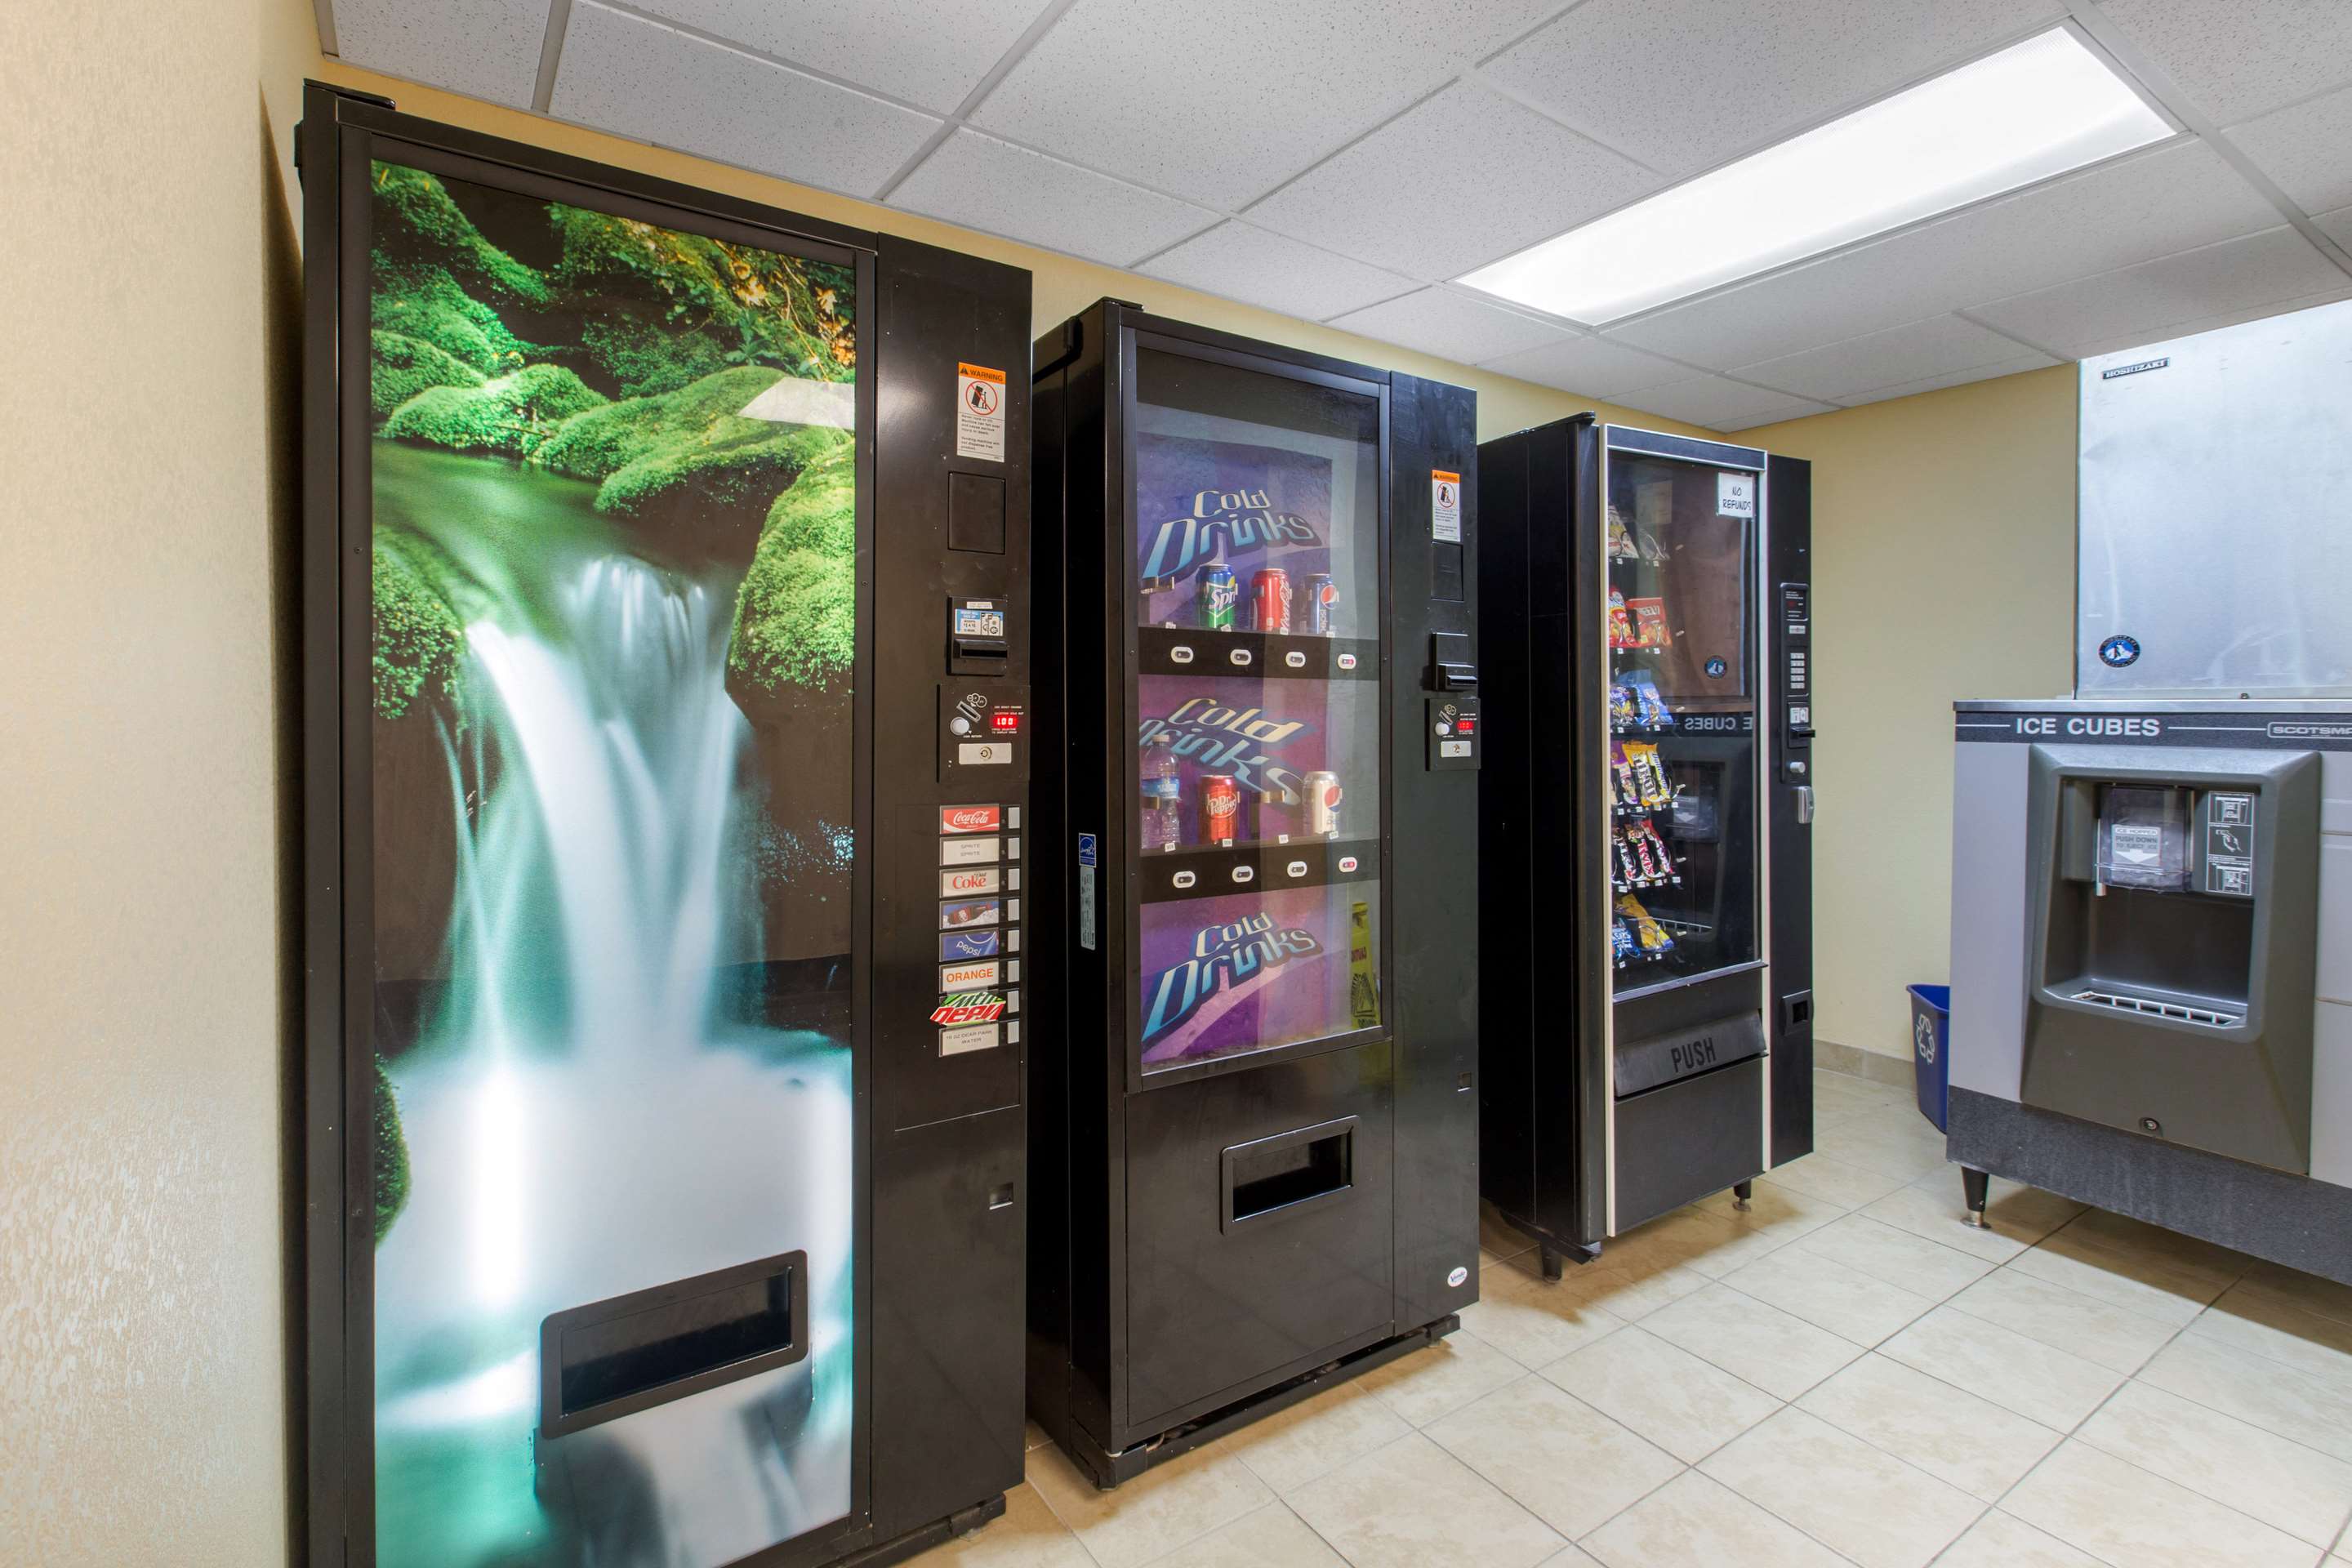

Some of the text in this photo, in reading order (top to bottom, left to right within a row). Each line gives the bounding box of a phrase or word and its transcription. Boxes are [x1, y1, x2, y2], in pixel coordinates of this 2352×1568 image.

[969, 369, 1004, 381] WARNING
[1732, 486, 1742, 497] NO
[1193, 489, 1272, 519] Cold
[1723, 498, 1752, 510] REFUNDS
[1142, 510, 1315, 579] Drinks
[1168, 698, 1305, 743] Cold
[2016, 718, 2161, 737] ICE CUBES
[952, 875, 987, 889] Coke
[1195, 911, 1273, 958] Cold
[956, 940, 982, 956] pepsi
[946, 968, 994, 982] ORANGE
[1141, 929, 1317, 1043] Drinks
[1670, 1036, 1717, 1073] PUSH
